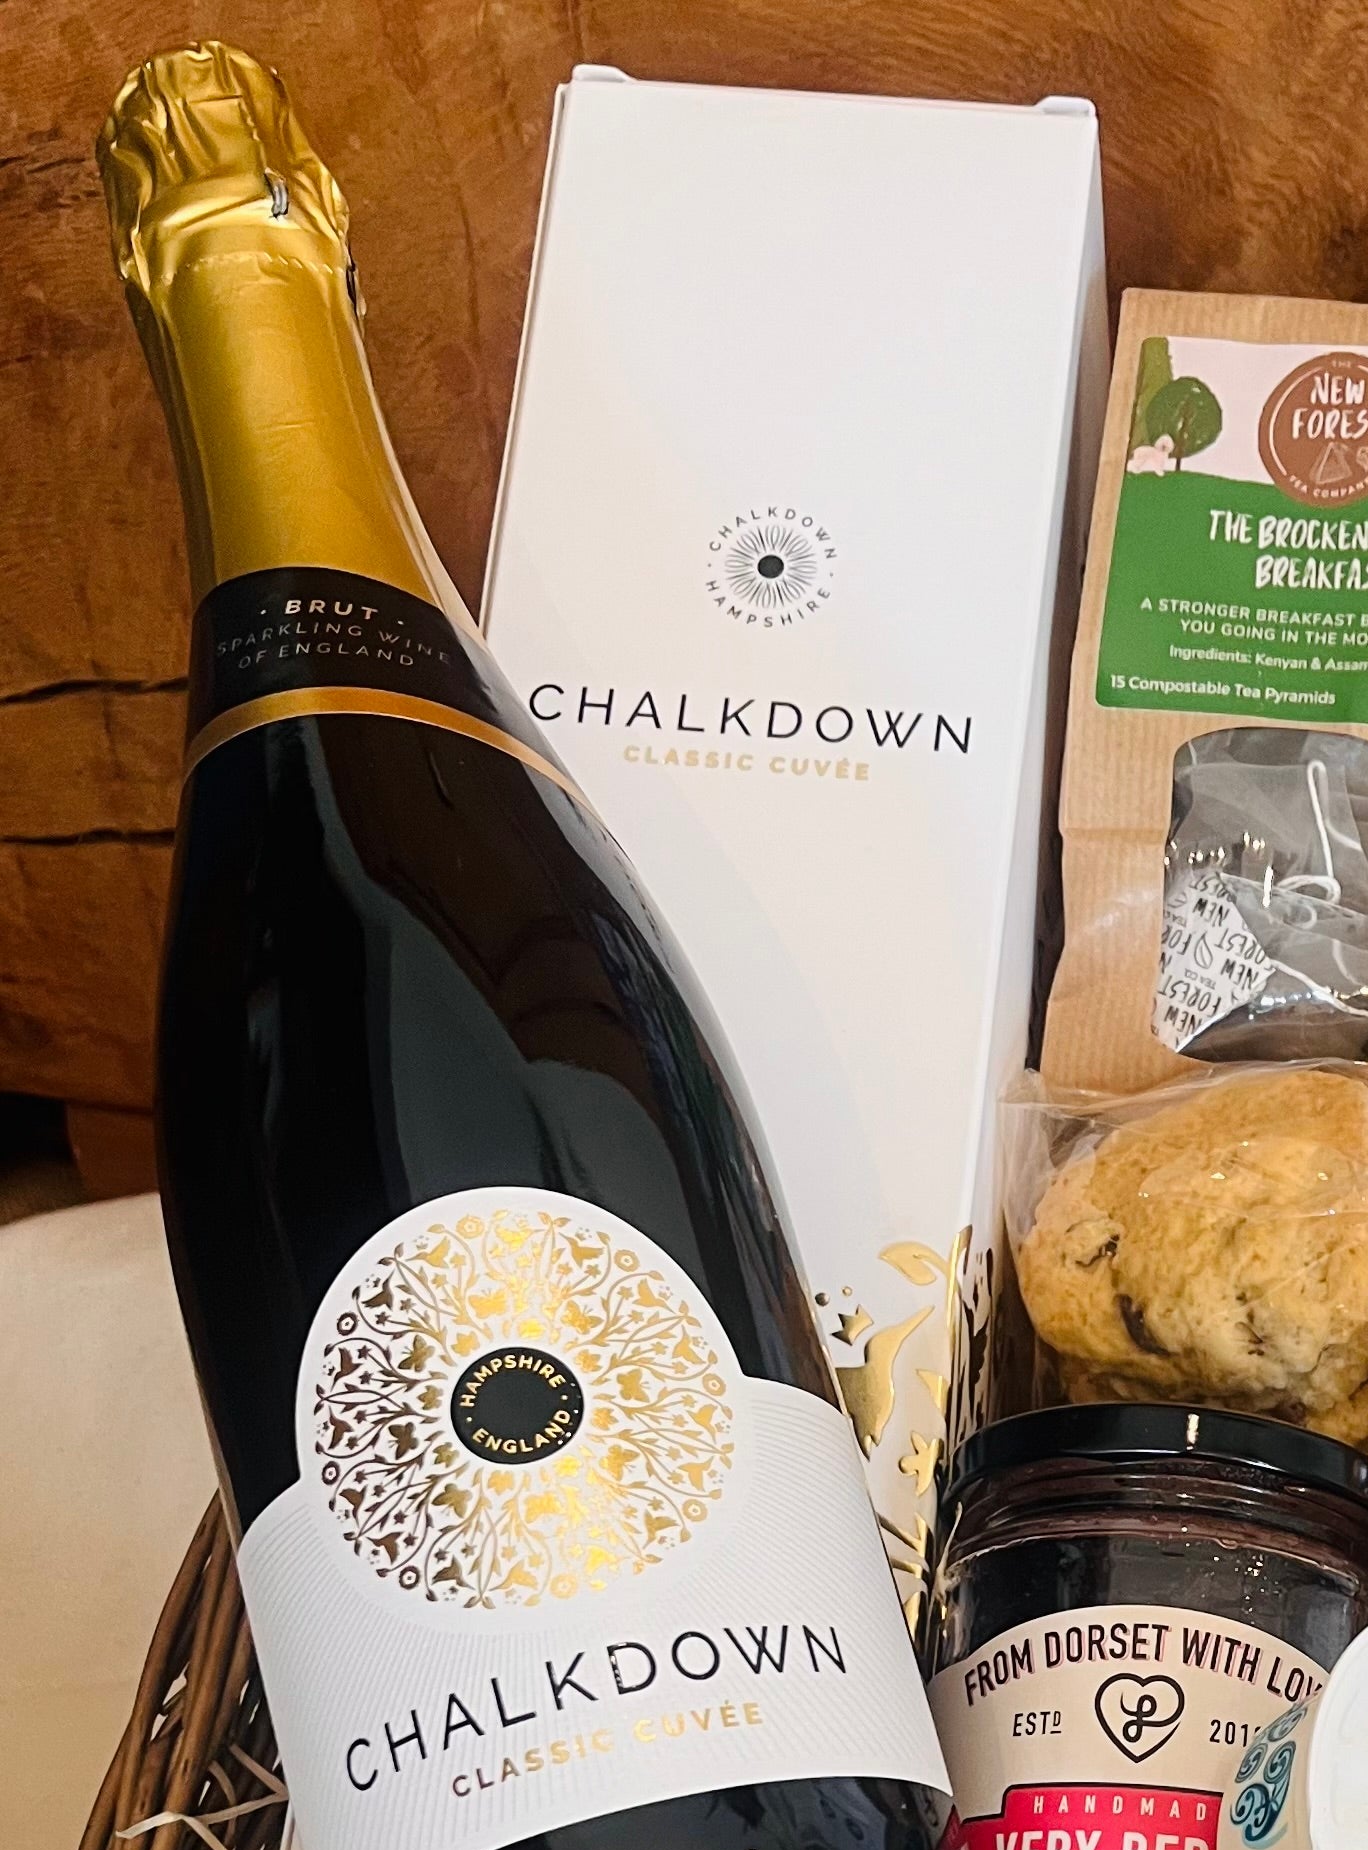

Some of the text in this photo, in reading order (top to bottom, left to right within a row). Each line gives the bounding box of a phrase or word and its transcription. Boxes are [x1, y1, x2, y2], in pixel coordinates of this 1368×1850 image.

[1310, 371, 1365, 405] NEW
[709, 506, 838, 559] CHALKDOWN
[1209, 510, 1253, 544] THE
[284, 599, 379, 620] BRUT
[705, 580, 831, 628] HAMPSHIRE
[1140, 598, 1153, 610] A
[1158, 598, 1250, 620] STRONGER
[1256, 609, 1355, 627] BREAKFAST
[217, 622, 450, 664] SPARKLING WINE
[1181, 619, 1214, 634] YOU
[1221, 623, 1275, 641] GOING
[1282, 629, 1298, 643] IN
[1305, 631, 1337, 645] THE
[238, 642, 414, 669] OF ENGLAND
[1170, 645, 1252, 665] Ingredients:
[1255, 653, 1307, 671] Kenyan
[1310, 657, 1321, 670] &
[1110, 674, 1335, 706] 15 Compostable Tea Pyramids
[527, 681, 976, 754] CHALKDOWN
[623, 744, 873, 782] CLASSIC CUVÉE
[460, 1354, 566, 1409] HAMPSHIRE
[471, 1405, 572, 1454] ENGLAND
[964, 1623, 1323, 1706] FROM DORSET WITH LOV
[345, 1624, 848, 1792] CHALKDOWN
[451, 1700, 764, 1799] CLASSIC CUVÉE
[1209, 1719, 1261, 1748] 201
[1034, 1795, 1206, 1821] HANDMAD
